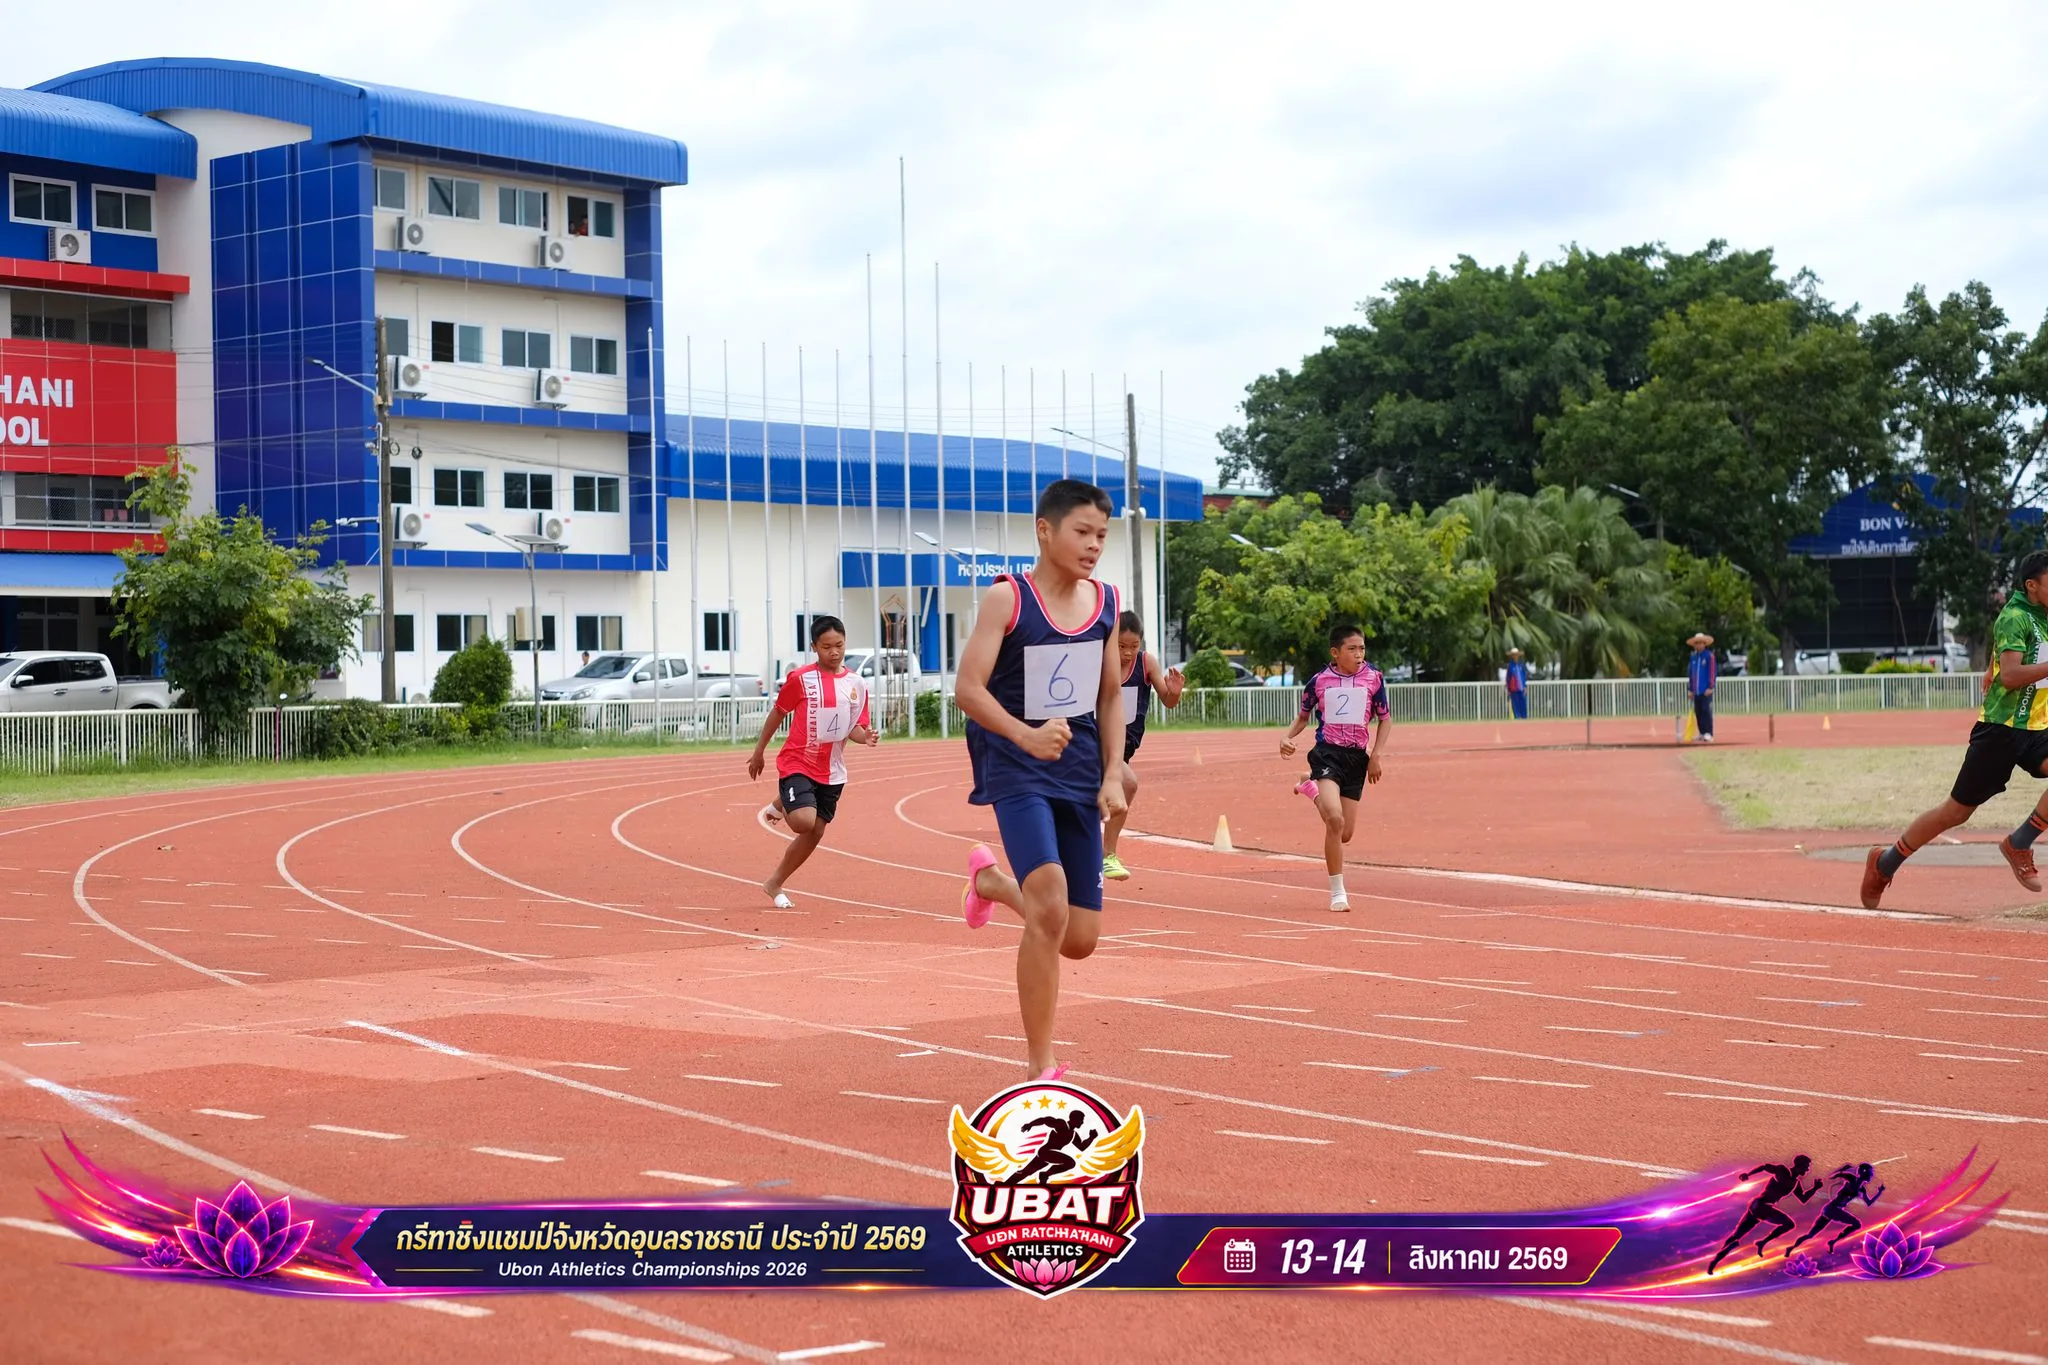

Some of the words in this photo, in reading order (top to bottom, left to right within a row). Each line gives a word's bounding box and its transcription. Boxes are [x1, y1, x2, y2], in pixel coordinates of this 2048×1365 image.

[1860, 517, 1891, 531] BON
[1048, 653, 1074, 702] 6
[1335, 694, 1350, 716] 2
[826, 713, 841, 735] 4
